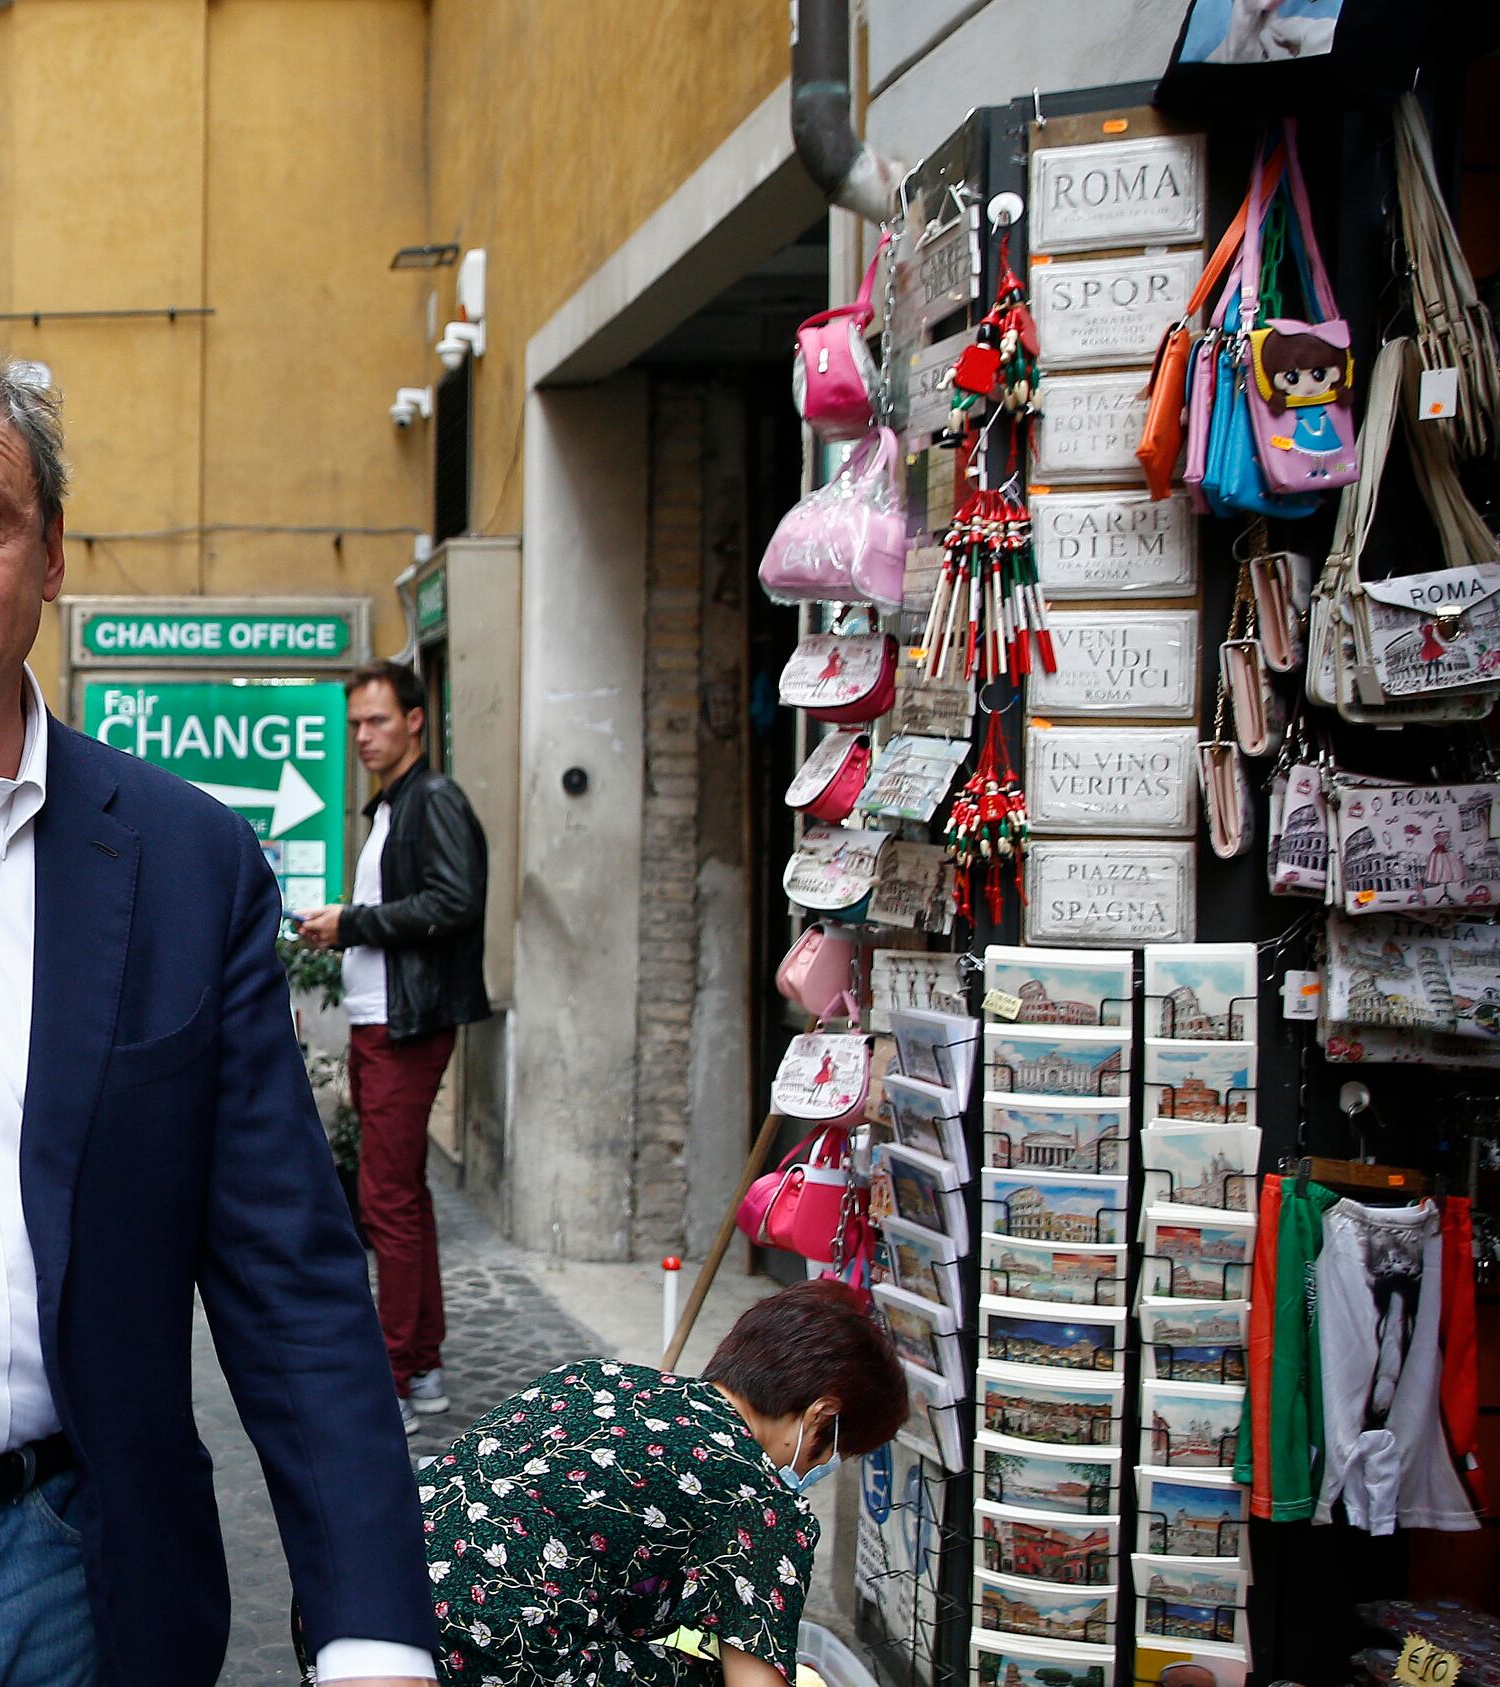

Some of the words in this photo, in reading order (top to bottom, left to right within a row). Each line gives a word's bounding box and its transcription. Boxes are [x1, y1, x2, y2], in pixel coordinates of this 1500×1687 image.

[1052, 163, 1181, 211] ROMA
[1072, 395, 1149, 413] PIAZZ
[1088, 433, 1137, 451] TRE
[1052, 508, 1171, 537] CARPE
[1058, 532, 1165, 561] DIEM
[1084, 569, 1133, 581] ROMA
[1409, 578, 1486, 607] ROMA
[95, 621, 222, 650] CHANGE
[228, 622, 337, 651] OFFICE
[1056, 629, 1129, 649] VENI
[1088, 648, 1156, 669] VIDI
[1106, 668, 1169, 688] VICI
[104, 689, 160, 716] Fair
[1084, 689, 1133, 701] ROMA
[96, 714, 327, 761] CHANGE
[1051, 751, 1081, 771] IN
[1094, 751, 1170, 773] VINO
[1049, 775, 1171, 799] VERITAS
[1392, 789, 1457, 807] ROMA
[1067, 863, 1151, 881] PIAZZA
[1095, 884, 1116, 897] DI
[1051, 900, 1166, 923] SPAGNA
[1393, 919, 1479, 942] ITALIA
